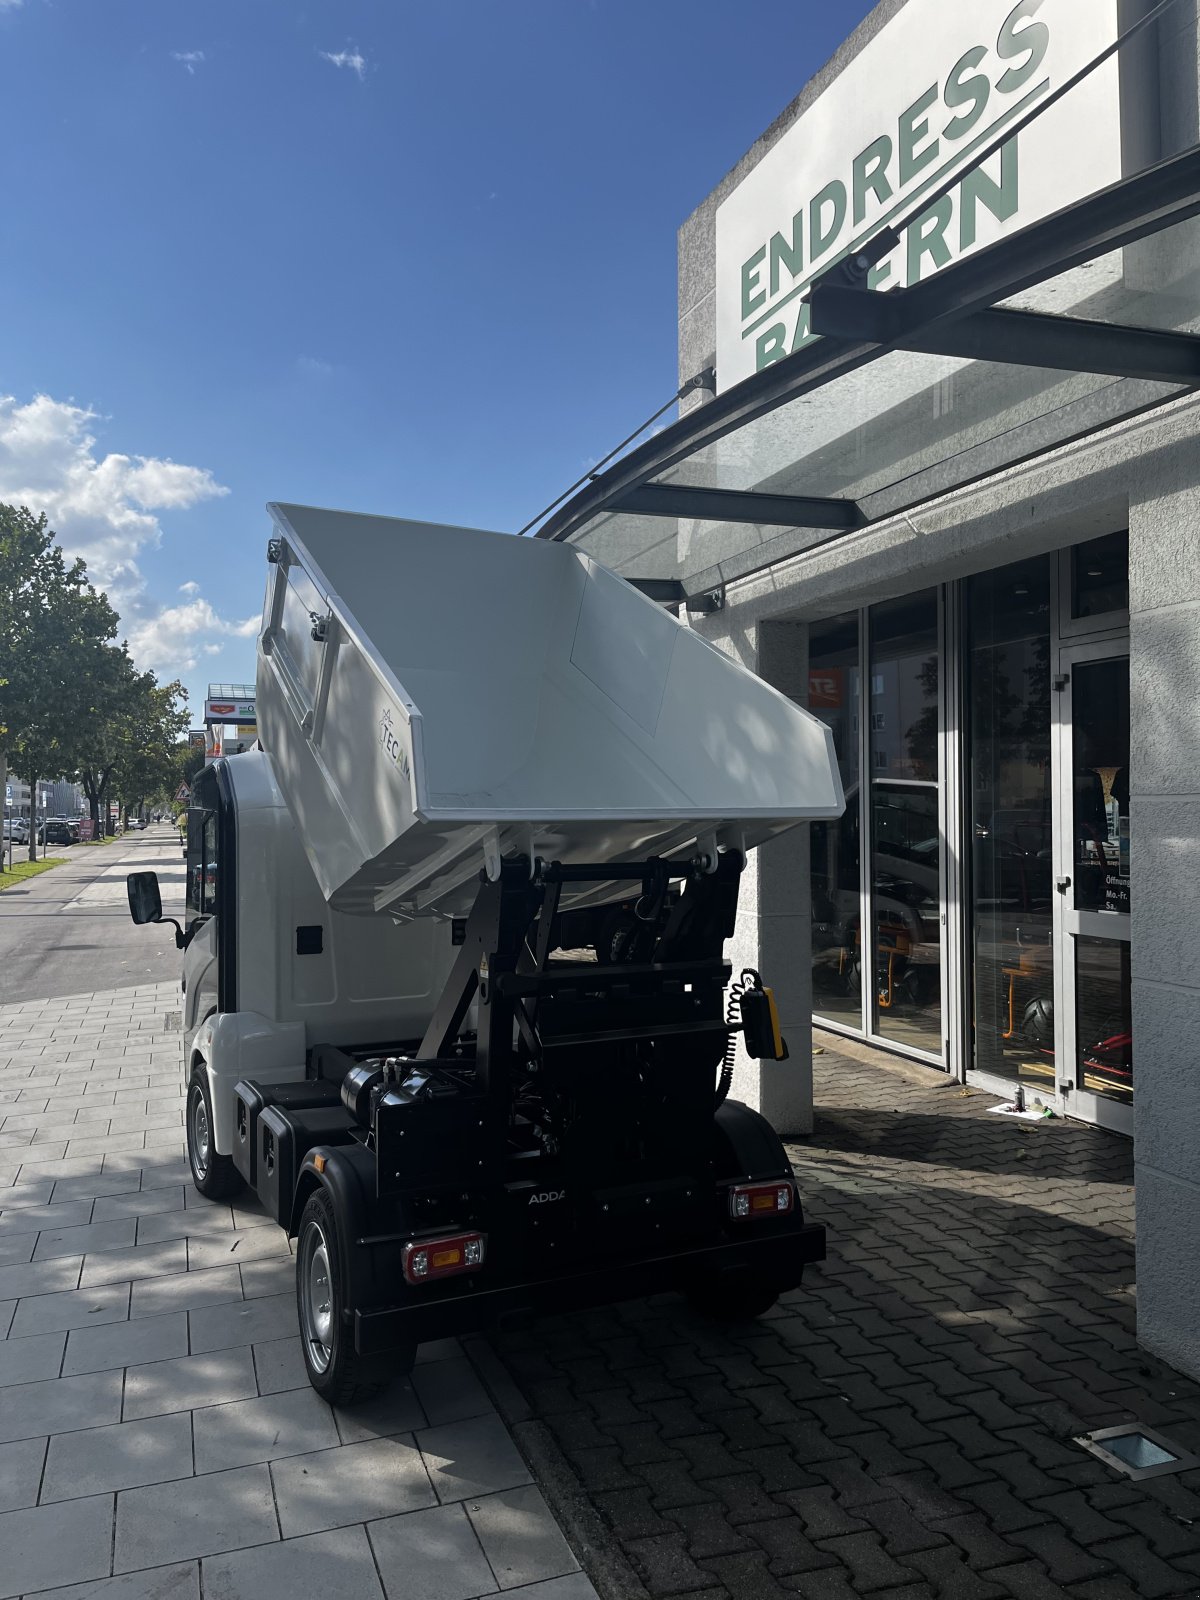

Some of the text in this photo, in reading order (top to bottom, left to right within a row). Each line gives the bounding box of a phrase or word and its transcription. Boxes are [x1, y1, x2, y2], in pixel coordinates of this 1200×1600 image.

[741, 0, 1050, 322] ENDRESS
[756, 132, 1019, 373] BARN
[1106, 889, 1128, 900] Mo.-Fr.
